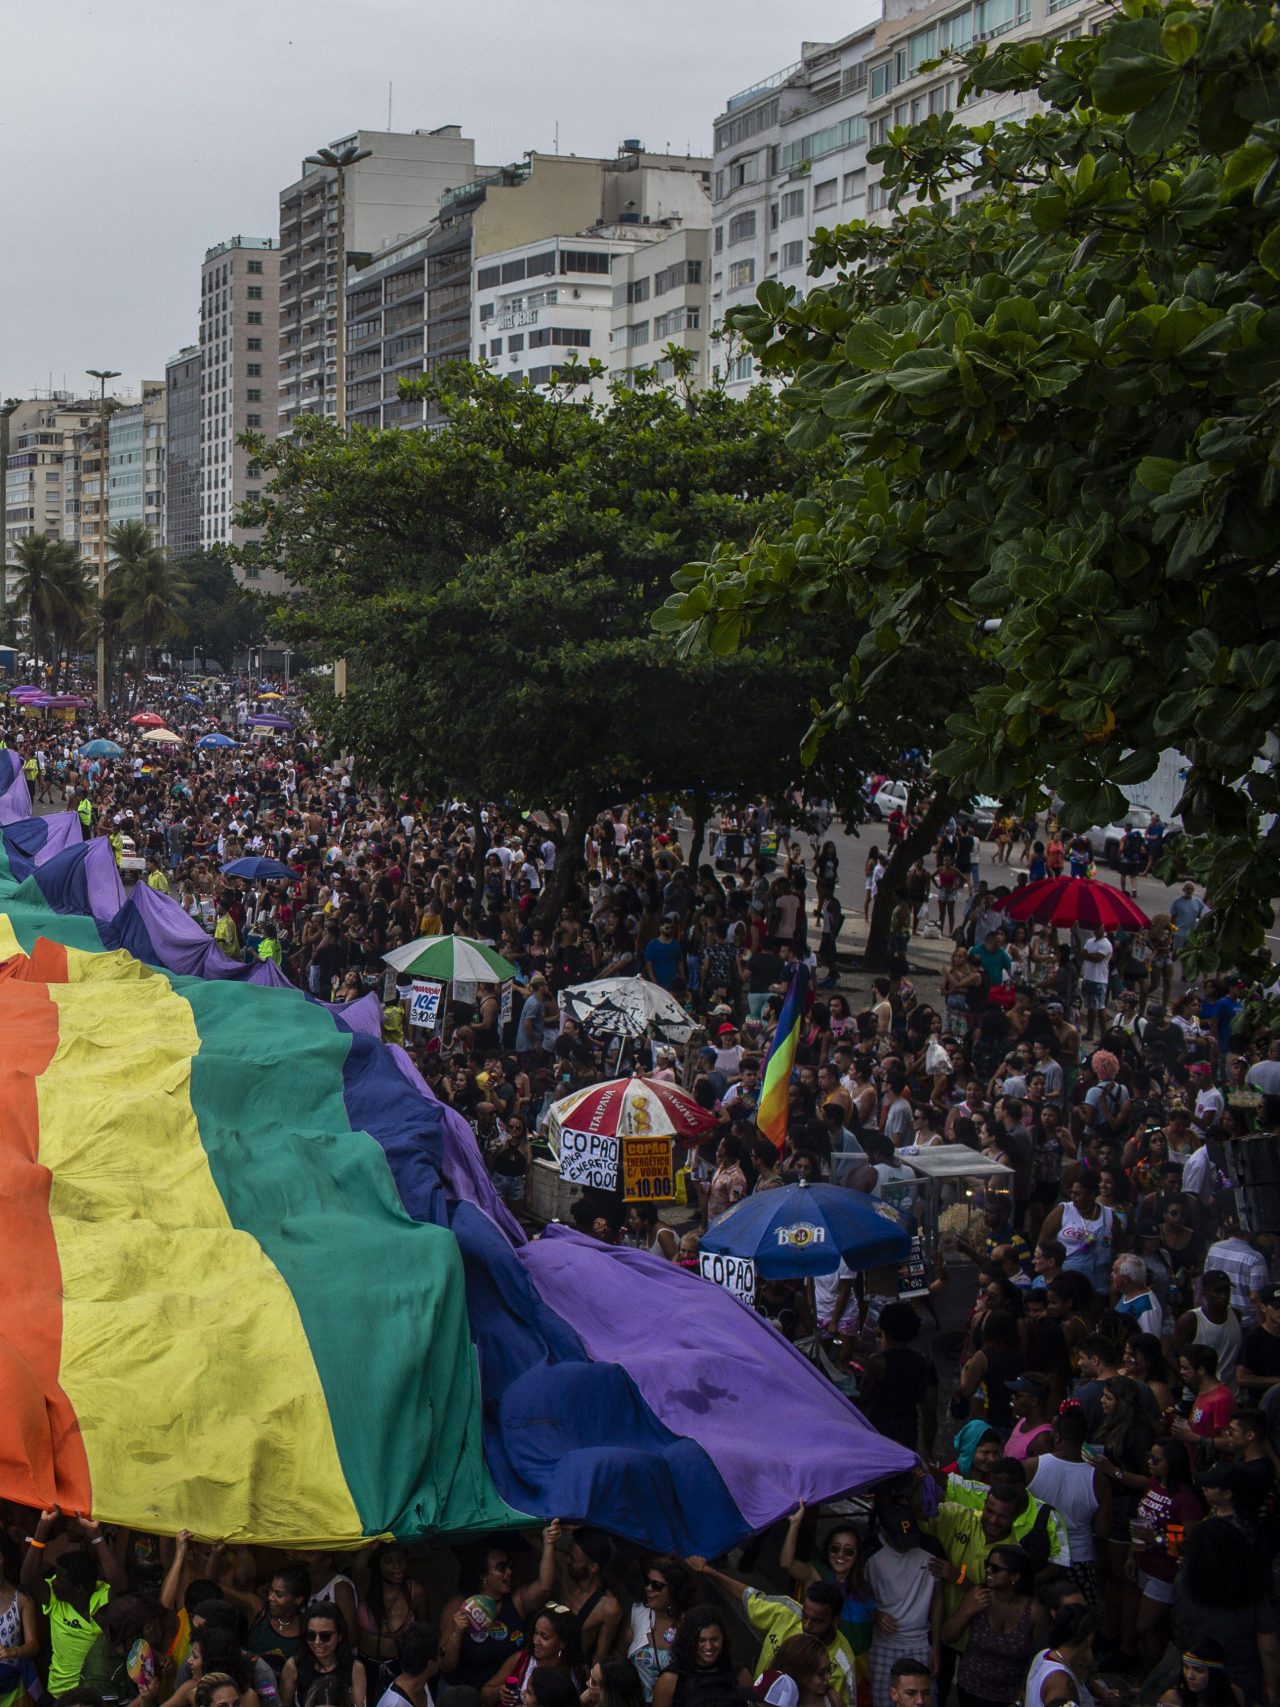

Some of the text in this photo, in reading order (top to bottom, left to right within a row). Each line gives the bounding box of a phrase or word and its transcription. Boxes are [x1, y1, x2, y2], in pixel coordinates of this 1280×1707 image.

[413, 994, 439, 1010] ICE
[588, 1090, 617, 1132] ITAIPAVA
[662, 1090, 699, 1127] ITAIPAVA
[640, 1167, 669, 1177] VODKA
[901, 1519, 910, 1534] P
[465, 1600, 493, 1628] LGBT
